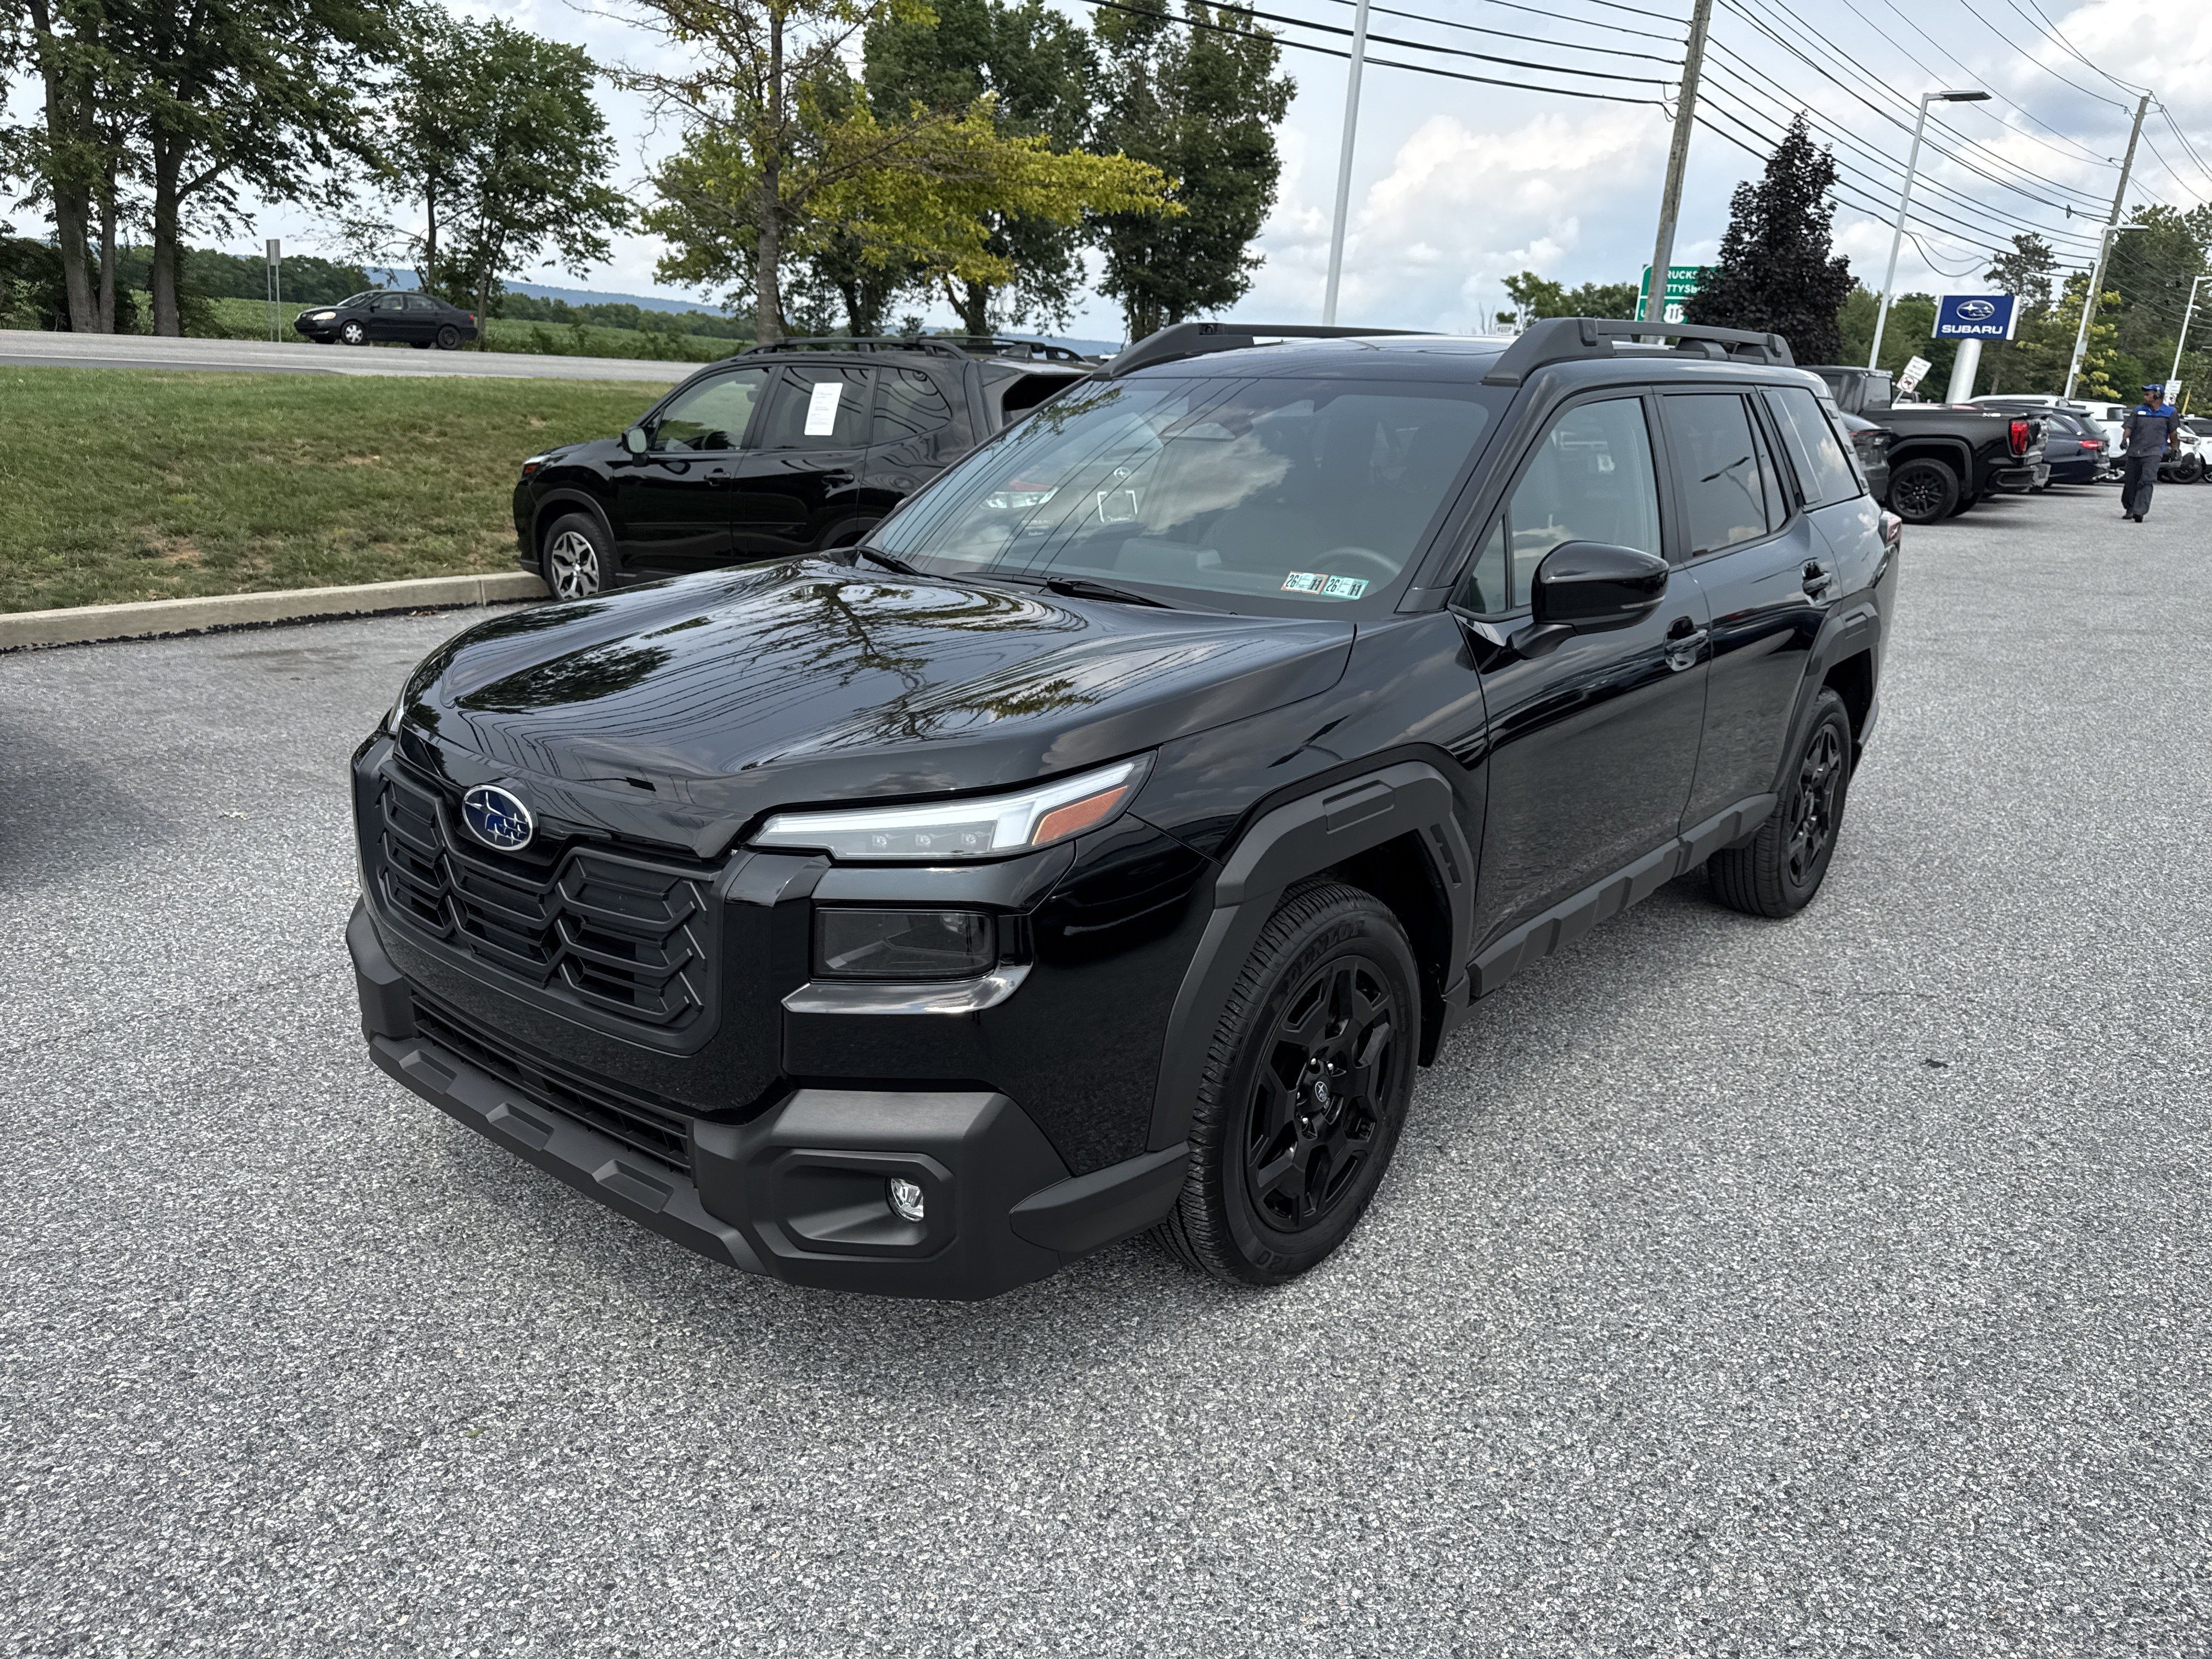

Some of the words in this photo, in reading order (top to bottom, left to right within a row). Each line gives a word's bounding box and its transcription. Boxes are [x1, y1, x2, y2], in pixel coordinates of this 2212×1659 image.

[1667, 270, 1699, 280] RUCKS
[1669, 308, 1679, 319] 11
[1941, 324, 2004, 335] SUBARU
[1285, 574, 1300, 588] 26
[1310, 578, 1323, 591] 11
[1325, 578, 1340, 592] 26
[1350, 584, 1362, 596] 11
